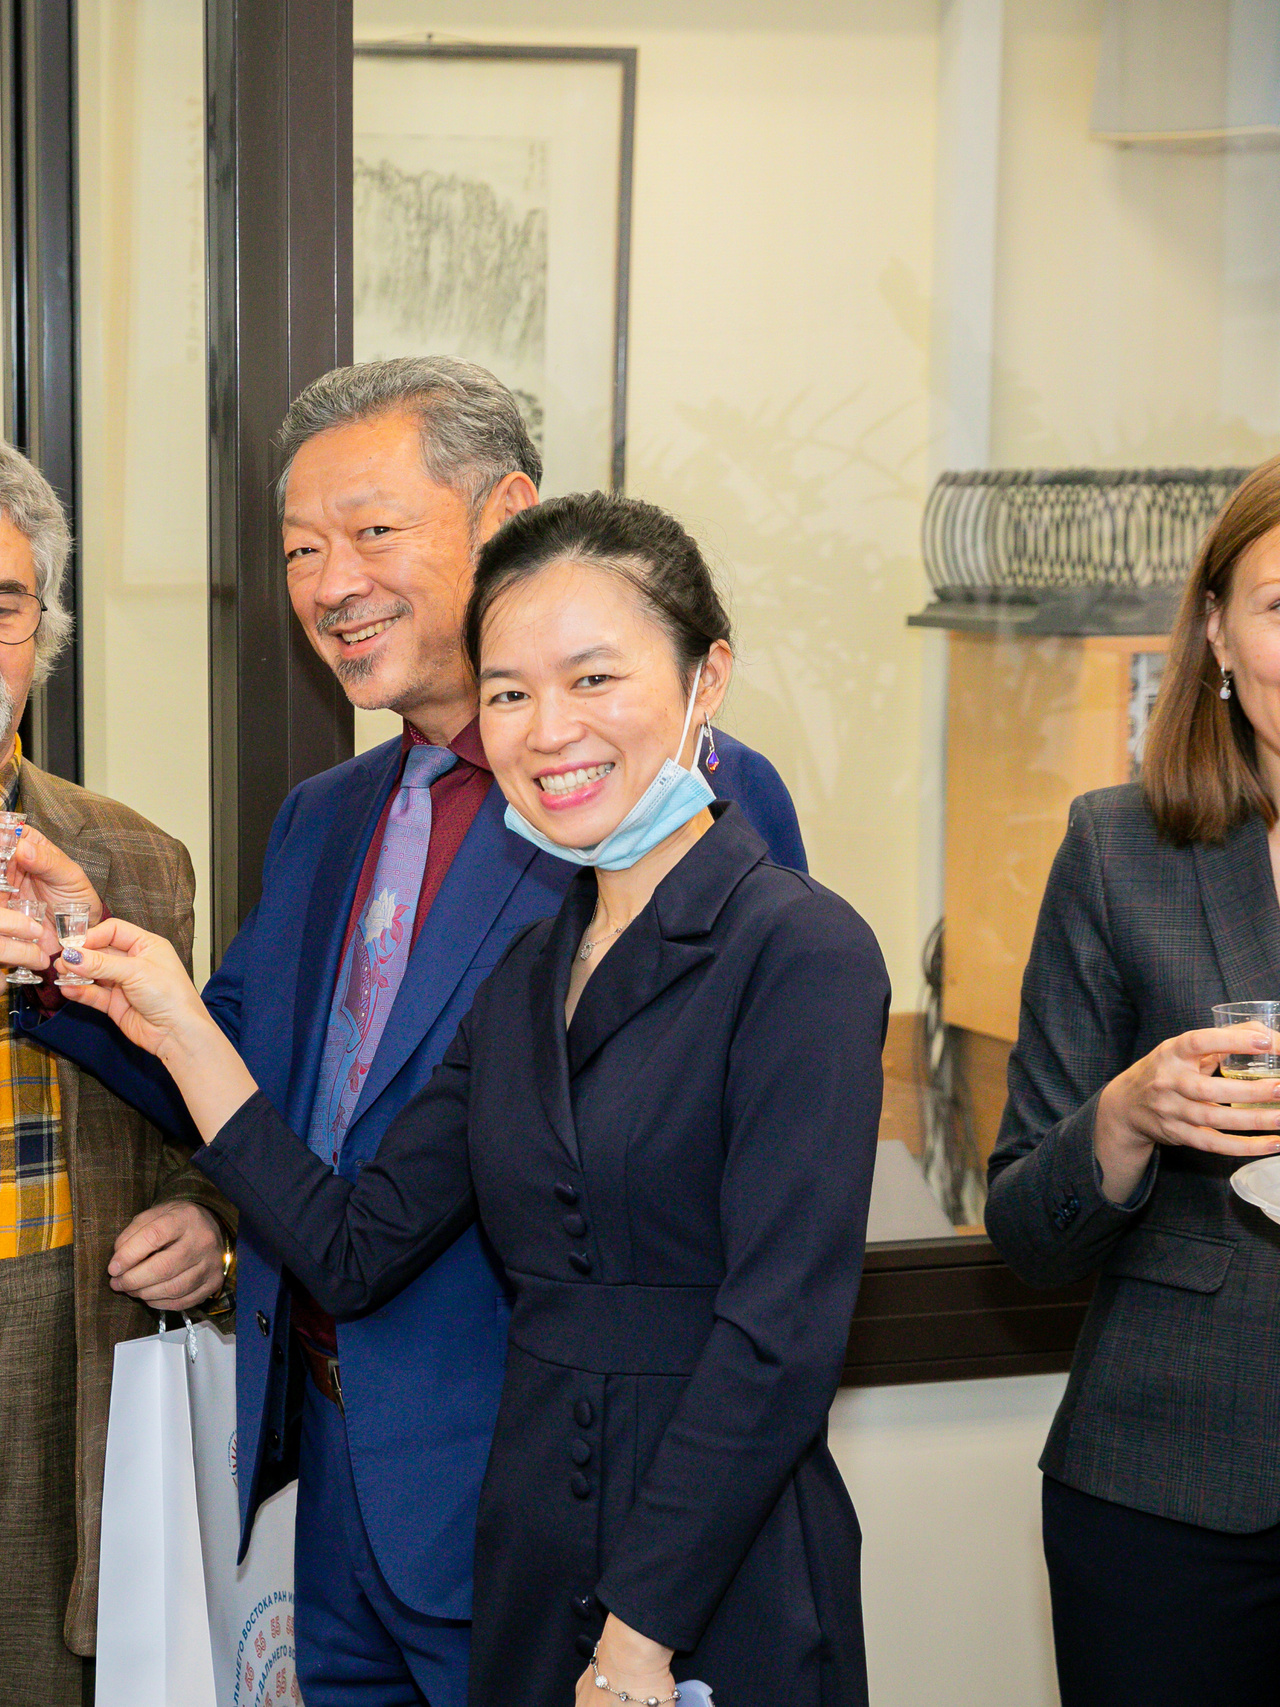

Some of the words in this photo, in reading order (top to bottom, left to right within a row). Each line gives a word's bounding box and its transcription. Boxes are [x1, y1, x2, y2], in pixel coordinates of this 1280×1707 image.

[241, 1595, 274, 1641] ВОСТОКА
[273, 1590, 287, 1604] РАН
[258, 1644, 288, 1696] ДАЛЬНЕГО
